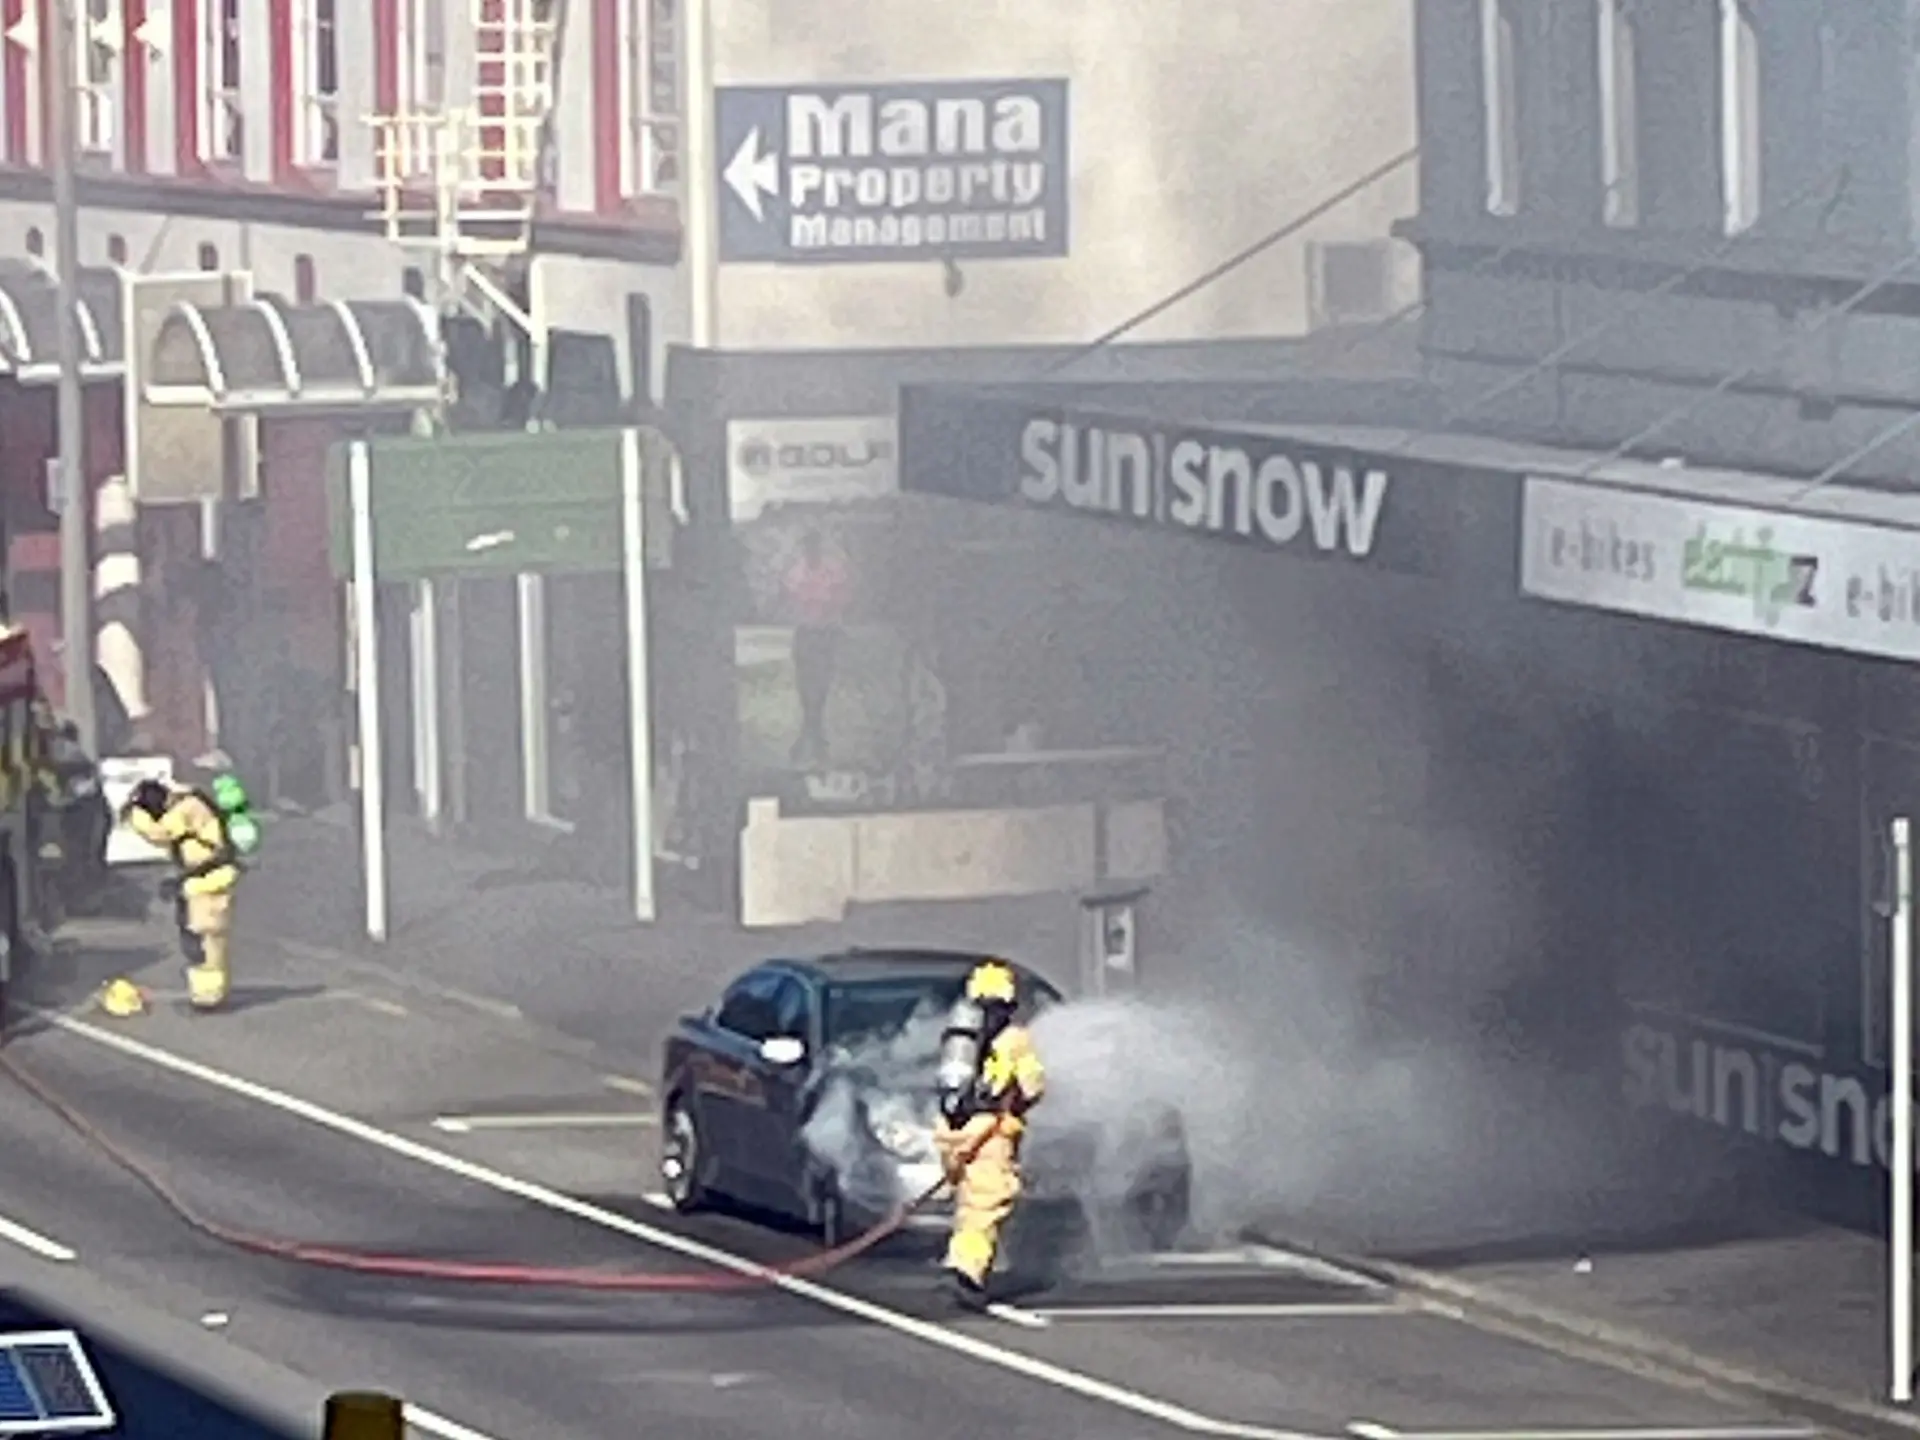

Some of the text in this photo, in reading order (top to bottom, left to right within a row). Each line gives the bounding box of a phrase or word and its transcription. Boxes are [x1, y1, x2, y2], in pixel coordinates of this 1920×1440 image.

[787, 93, 1041, 158] Mana
[790, 160, 1045, 208] Property
[790, 208, 1046, 248] Management
